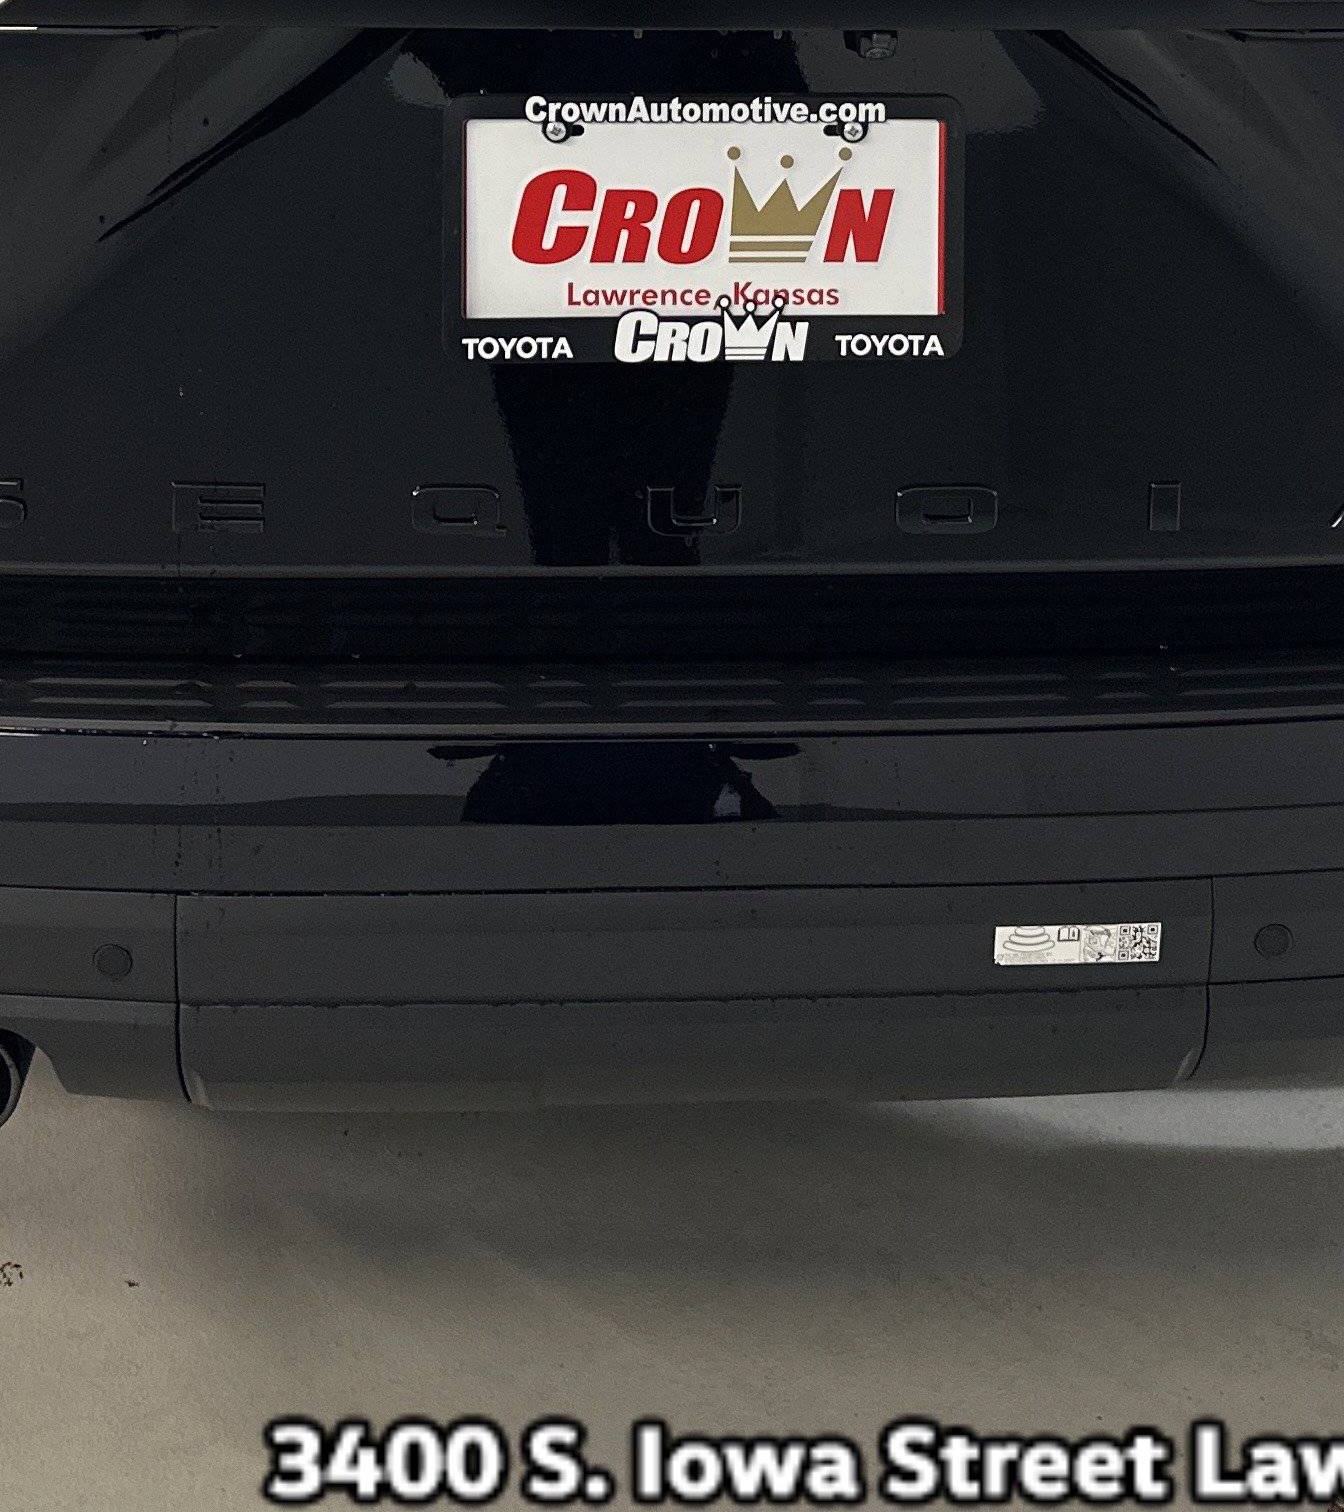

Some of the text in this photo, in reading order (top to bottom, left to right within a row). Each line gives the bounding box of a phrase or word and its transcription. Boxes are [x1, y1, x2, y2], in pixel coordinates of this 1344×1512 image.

[525, 96, 885, 123] CrownAutomotive.com
[732, 281, 840, 307] Kansas
[462, 336, 574, 360] TOYOTA
[835, 333, 945, 357] TOYOTA
